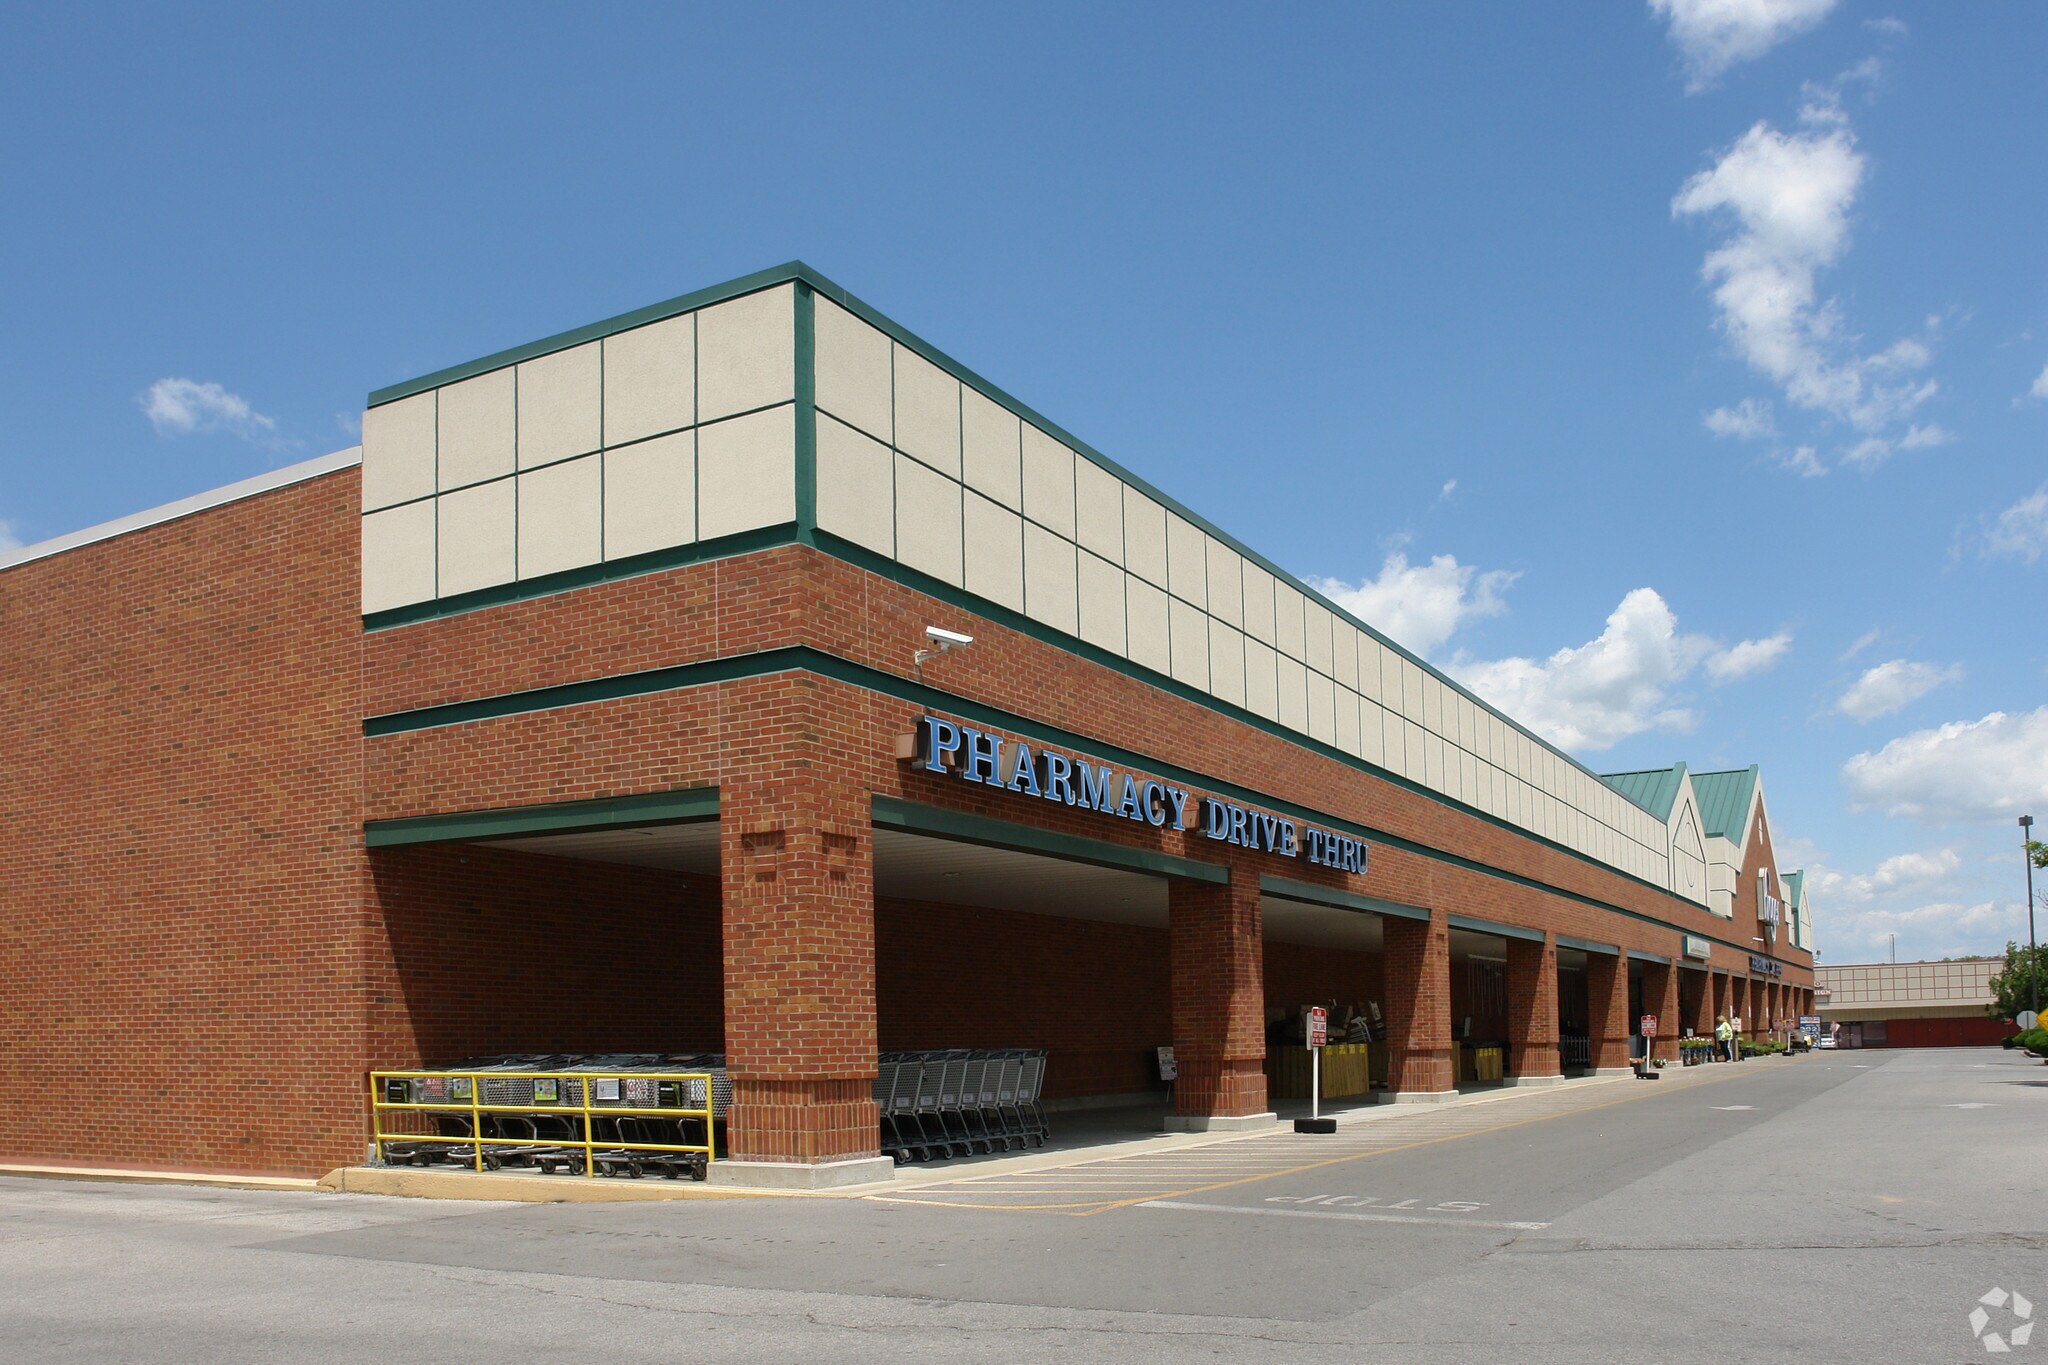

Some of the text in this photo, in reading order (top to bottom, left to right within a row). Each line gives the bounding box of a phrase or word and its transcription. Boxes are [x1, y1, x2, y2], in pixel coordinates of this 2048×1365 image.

[924, 715, 1369, 876] PHARMACY DRIVE THRU
[1264, 1194, 1491, 1212] STOP
